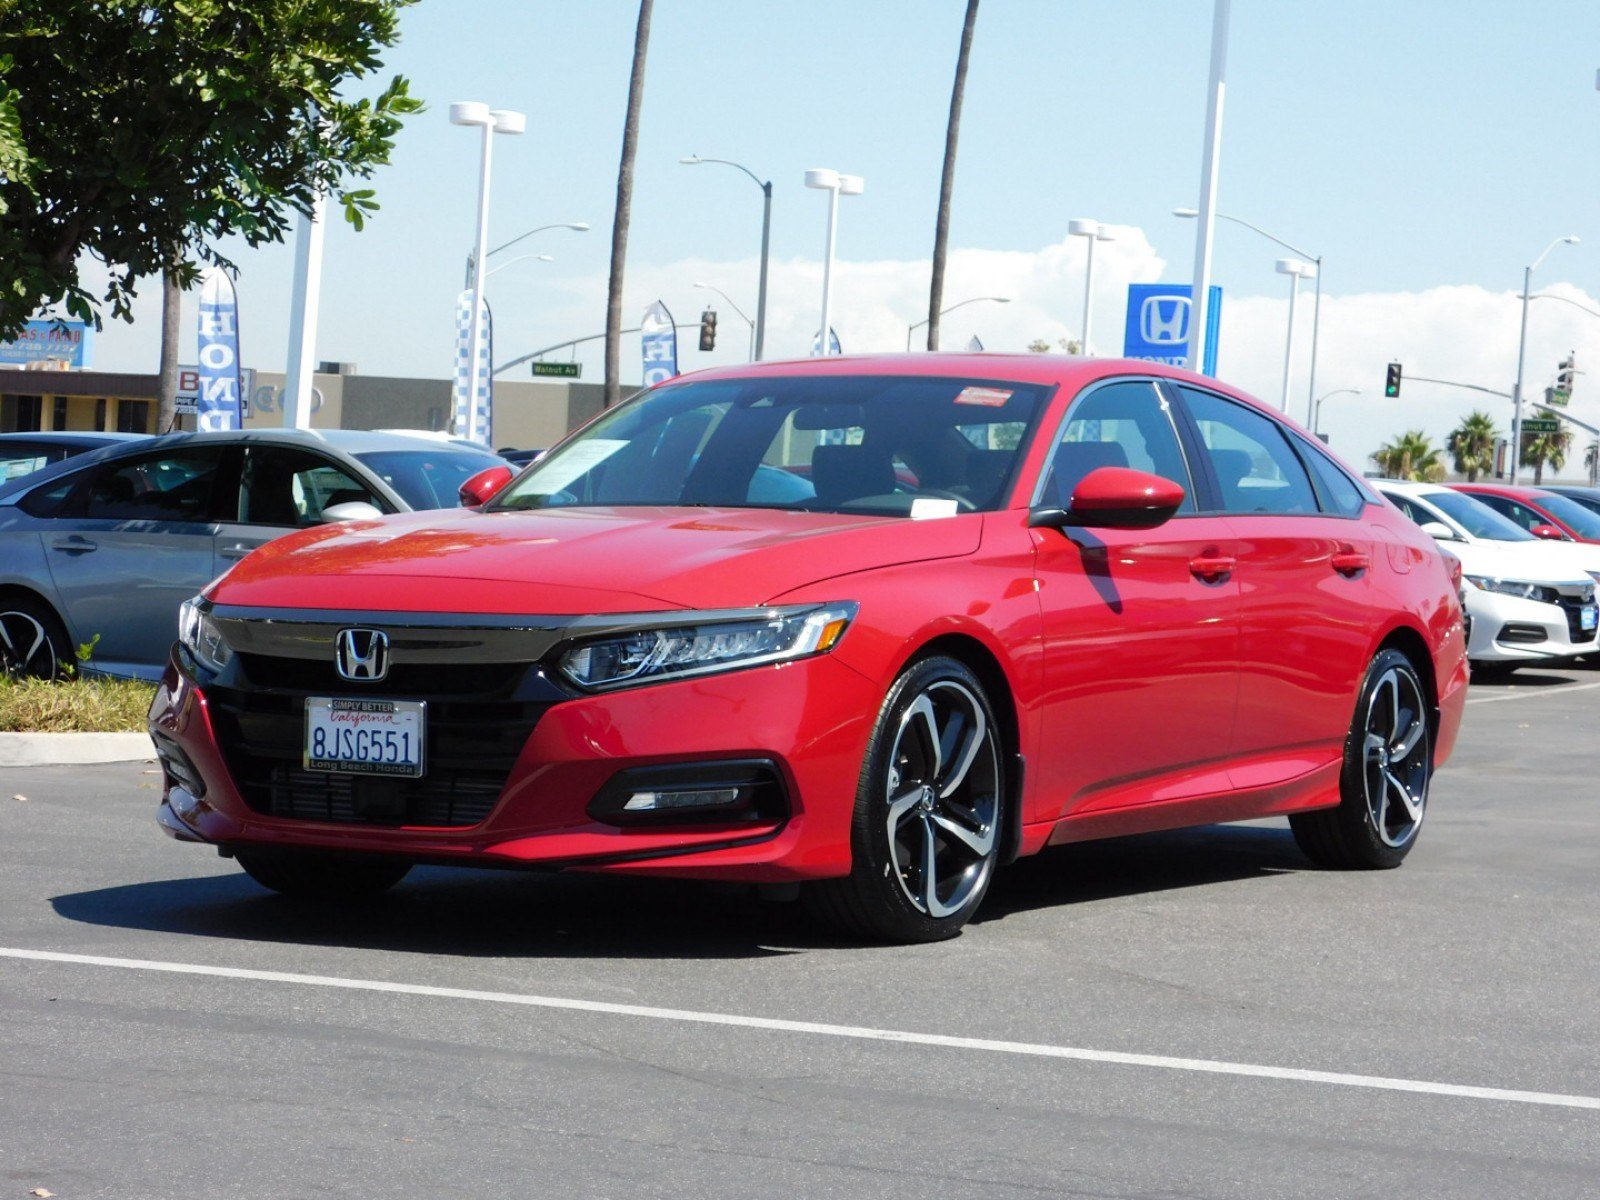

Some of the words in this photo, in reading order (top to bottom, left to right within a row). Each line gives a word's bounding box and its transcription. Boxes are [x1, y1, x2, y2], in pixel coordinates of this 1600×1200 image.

[535, 366, 562, 374] Walnut
[333, 700, 360, 710] SIMPLY
[361, 701, 393, 712] BETTER
[331, 711, 400, 727] California
[313, 727, 413, 763] 8JSG551
[310, 760, 338, 771] Long
[340, 761, 373, 771] Beach
[375, 762, 413, 773] Honda
